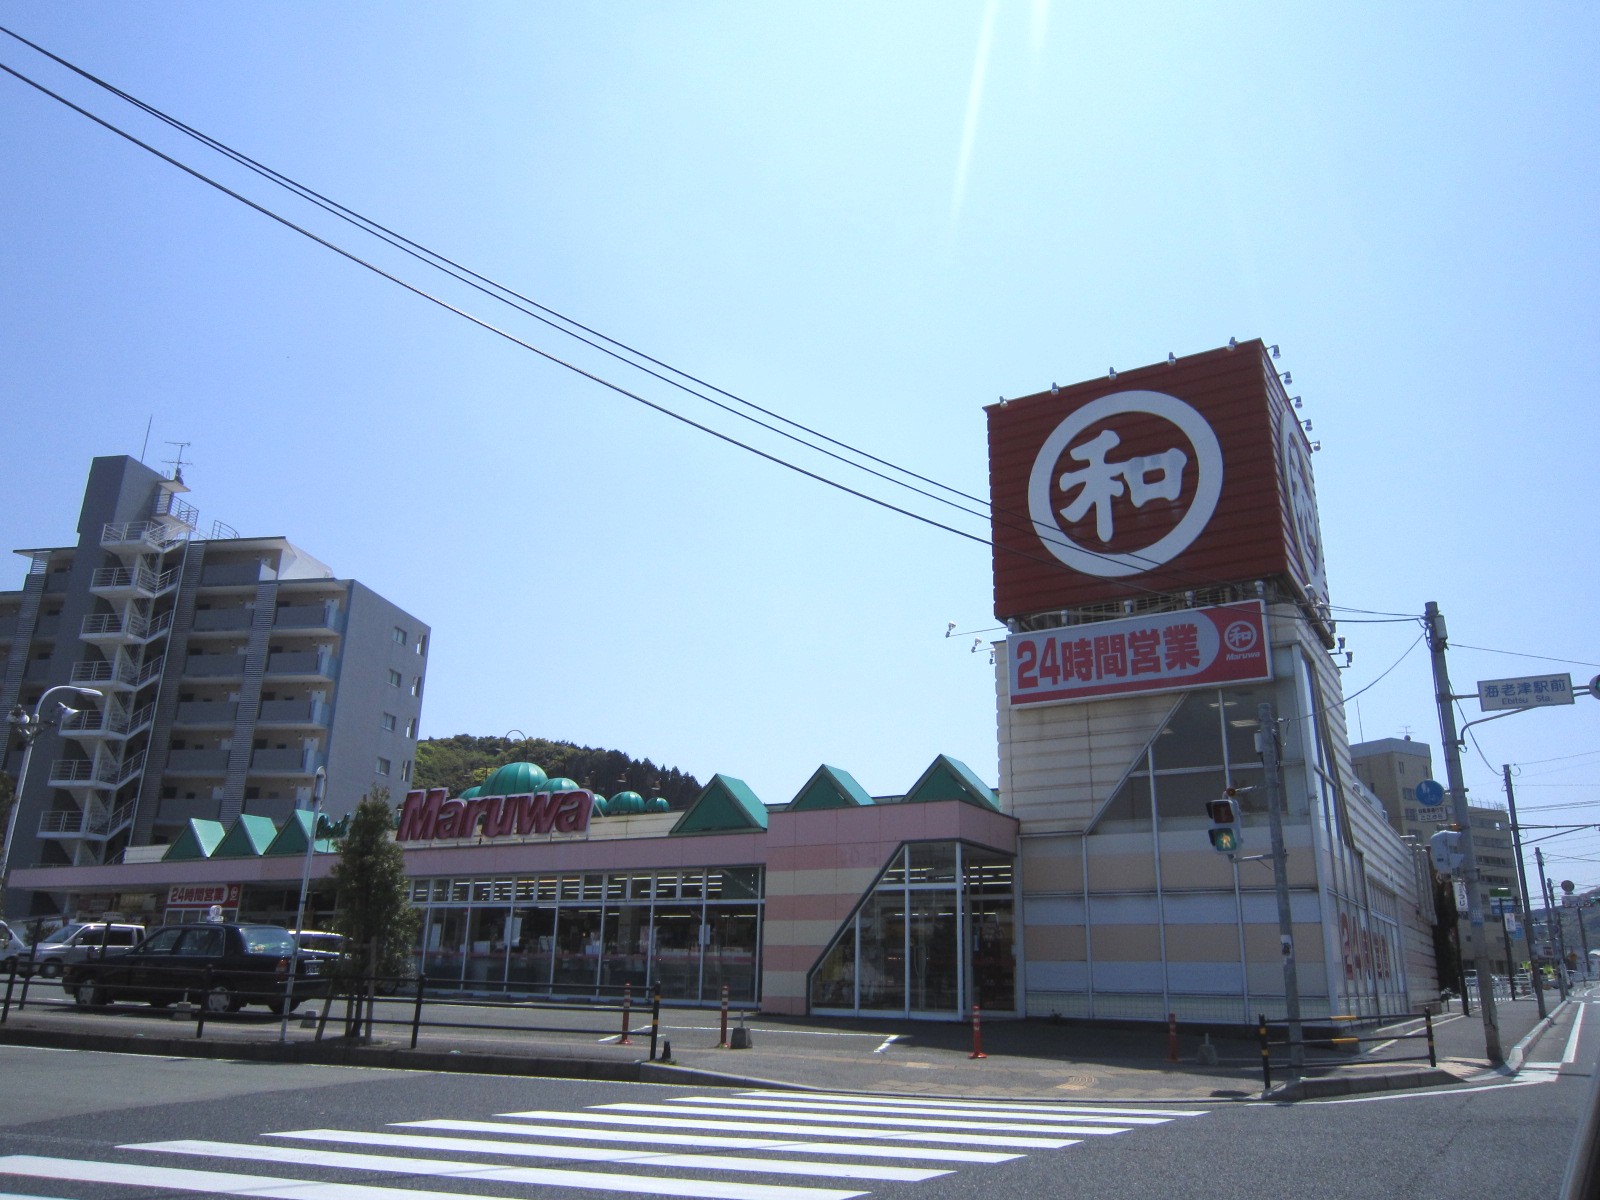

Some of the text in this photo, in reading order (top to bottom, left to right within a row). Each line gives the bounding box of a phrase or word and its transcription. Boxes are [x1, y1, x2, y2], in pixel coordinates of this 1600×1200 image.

[1059, 430, 1188, 543] 和
[1017, 623, 1201, 689] 24時間営業
[1225, 651, 1261, 661] Maruwa
[1484, 679, 1566, 698] 海老津駅前
[395, 787, 595, 842] Maruwa
[171, 887, 225, 902] 24時間営業
